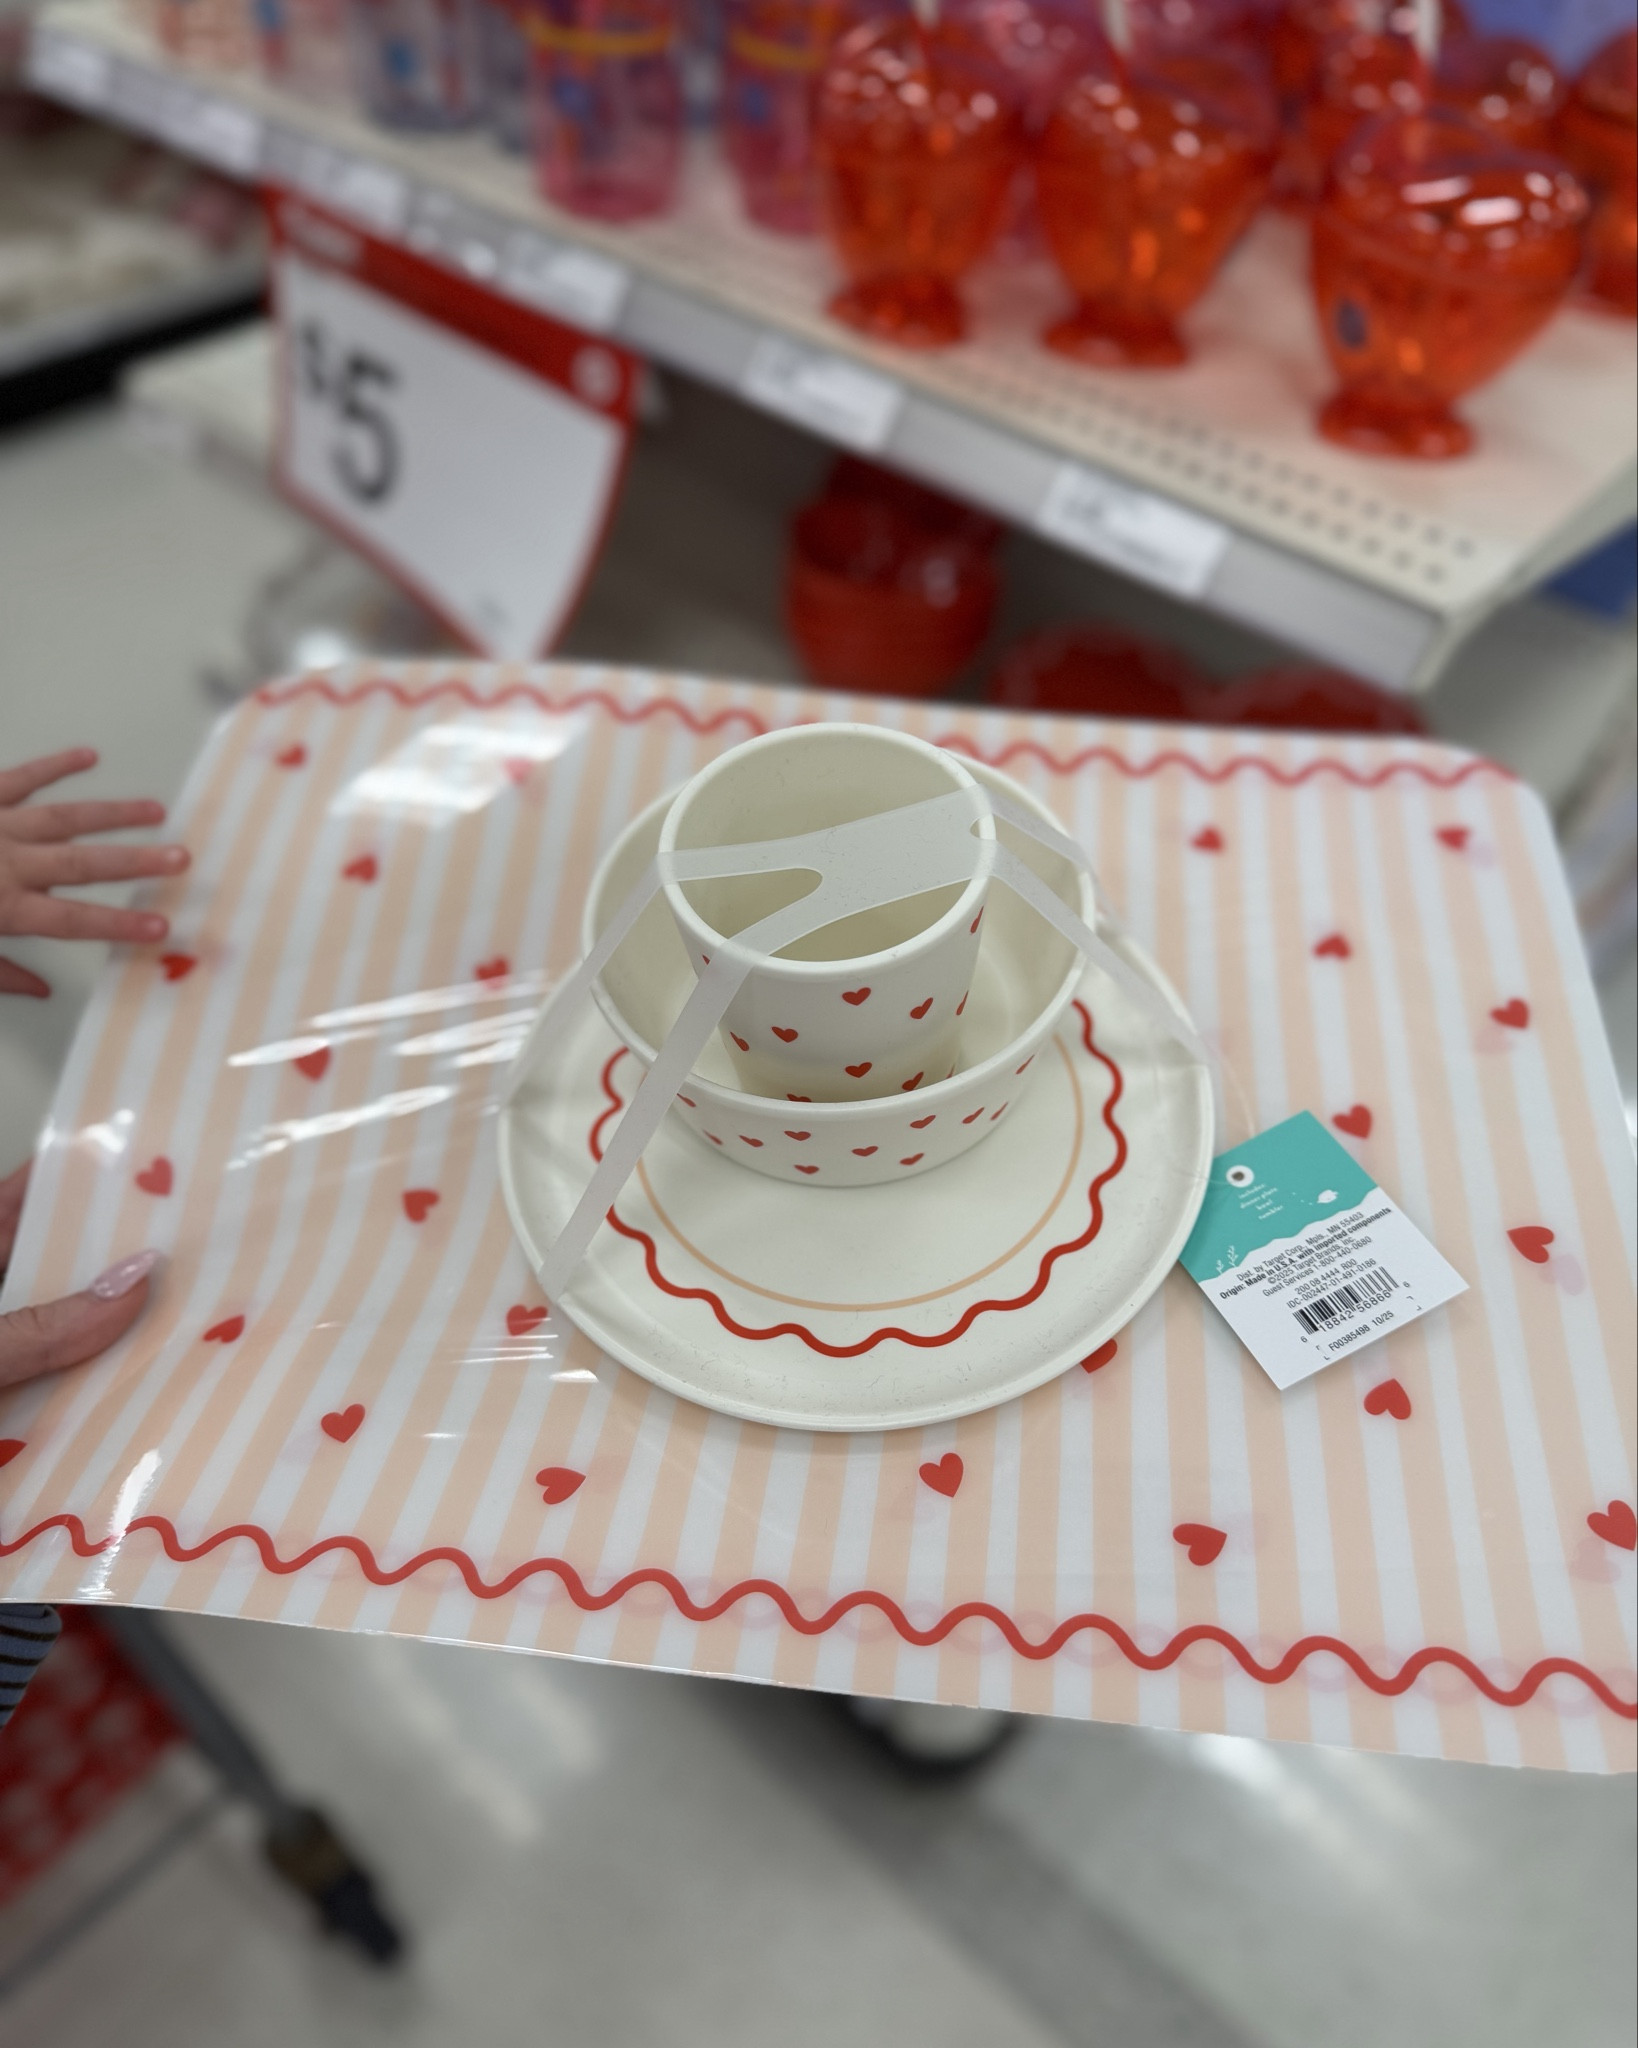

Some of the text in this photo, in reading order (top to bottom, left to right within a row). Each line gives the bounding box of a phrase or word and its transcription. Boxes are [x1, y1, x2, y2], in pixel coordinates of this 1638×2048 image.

[1219, 1207, 1392, 1299] Origin: Made in U.S.A. with imported components
[1236, 1269, 1254, 1281] Dist.
[1253, 1264, 1264, 1275] by
[1262, 1252, 1286, 1268] Target
[1326, 1223, 1341, 1234] MN
[1339, 1211, 1364, 1228] 55403
[1262, 1235, 1372, 1297] Guest Services 1-800-440-0680
[1267, 1267, 1294, 1284] ©2025
[1292, 1255, 1317, 1271] Target
[1341, 1236, 1356, 1246] Inc.
[1294, 1282, 1311, 1295] 200
[1309, 1277, 1322, 1288] 08
[1320, 1267, 1340, 1281] 4444
[1299, 1335, 1308, 1344] 6
[1318, 1309, 1355, 1333] 18842
[1355, 1289, 1392, 1313] 56866
[1328, 1309, 1395, 1352] F00385498 10/25
